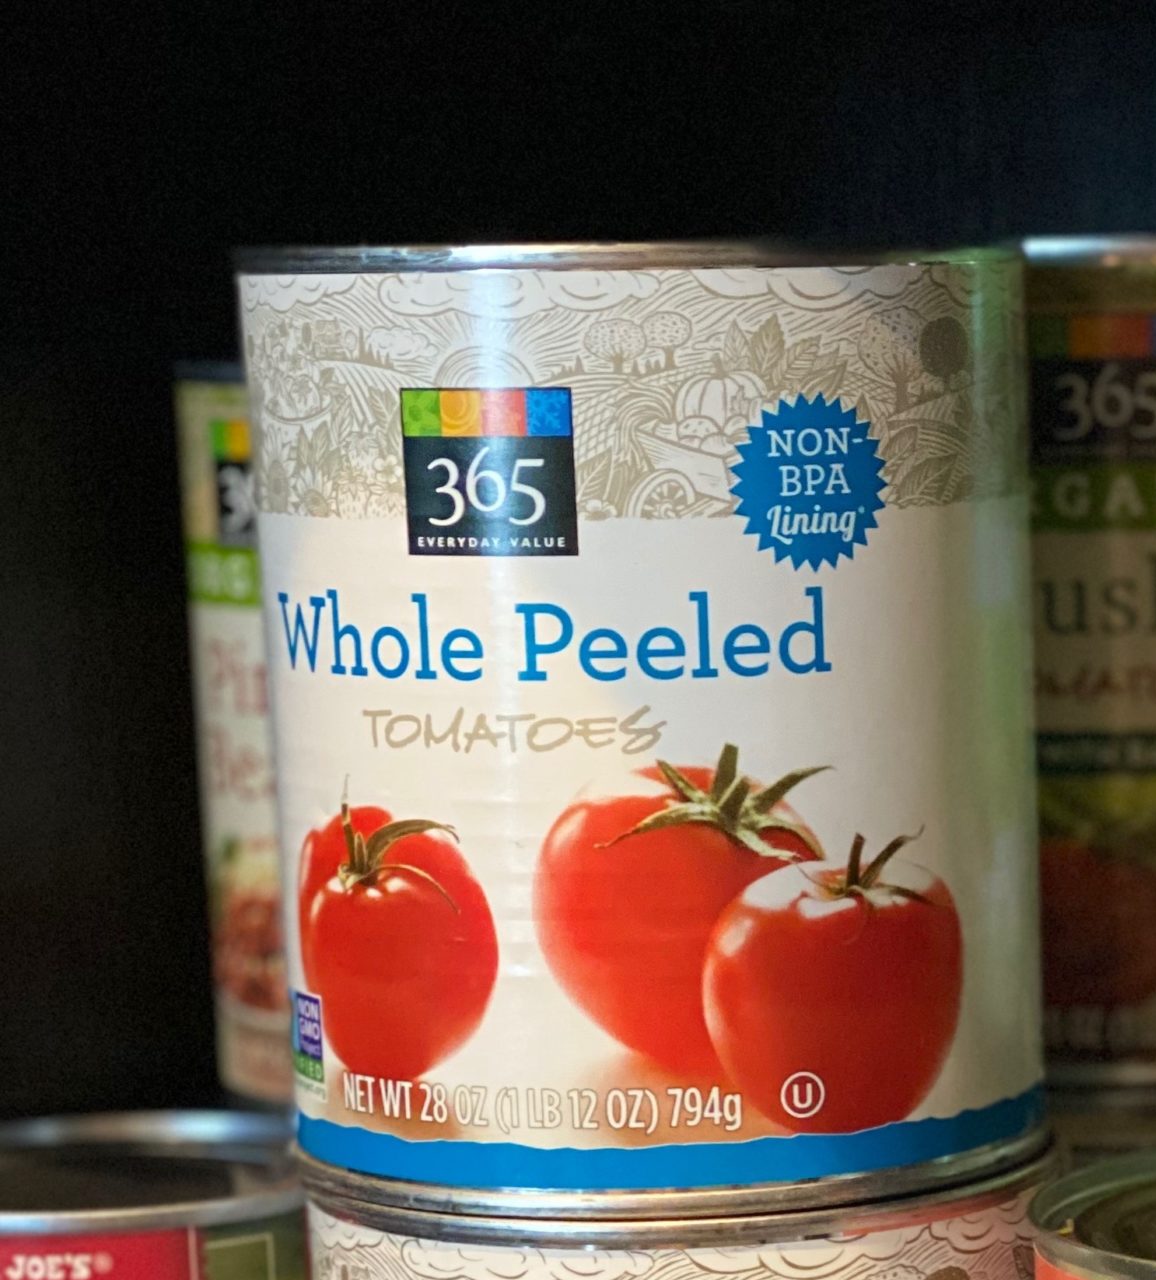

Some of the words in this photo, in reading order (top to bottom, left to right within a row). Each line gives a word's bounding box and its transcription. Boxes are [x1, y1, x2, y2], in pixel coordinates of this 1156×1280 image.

[766, 428, 864, 459] NON-
[427, 446, 547, 526] 365
[778, 465, 852, 498] BPA
[417, 535, 501, 549] EVERYDAY
[509, 535, 567, 549] VALUE
[277, 588, 485, 682] Whole
[516, 586, 832, 683] Peeled
[362, 704, 669, 756] TOMATOES
[343, 1071, 375, 1114] NET
[379, 1077, 413, 1120] WT
[419, 1082, 448, 1124] 28
[453, 1085, 489, 1127] OZ
[496, 1086, 520, 1134] (1
[527, 1088, 562, 1130] LB
[571, 1088, 599, 1130] 12
[606, 1088, 658, 1135] OZ)
[666, 1086, 744, 1131] 794g
